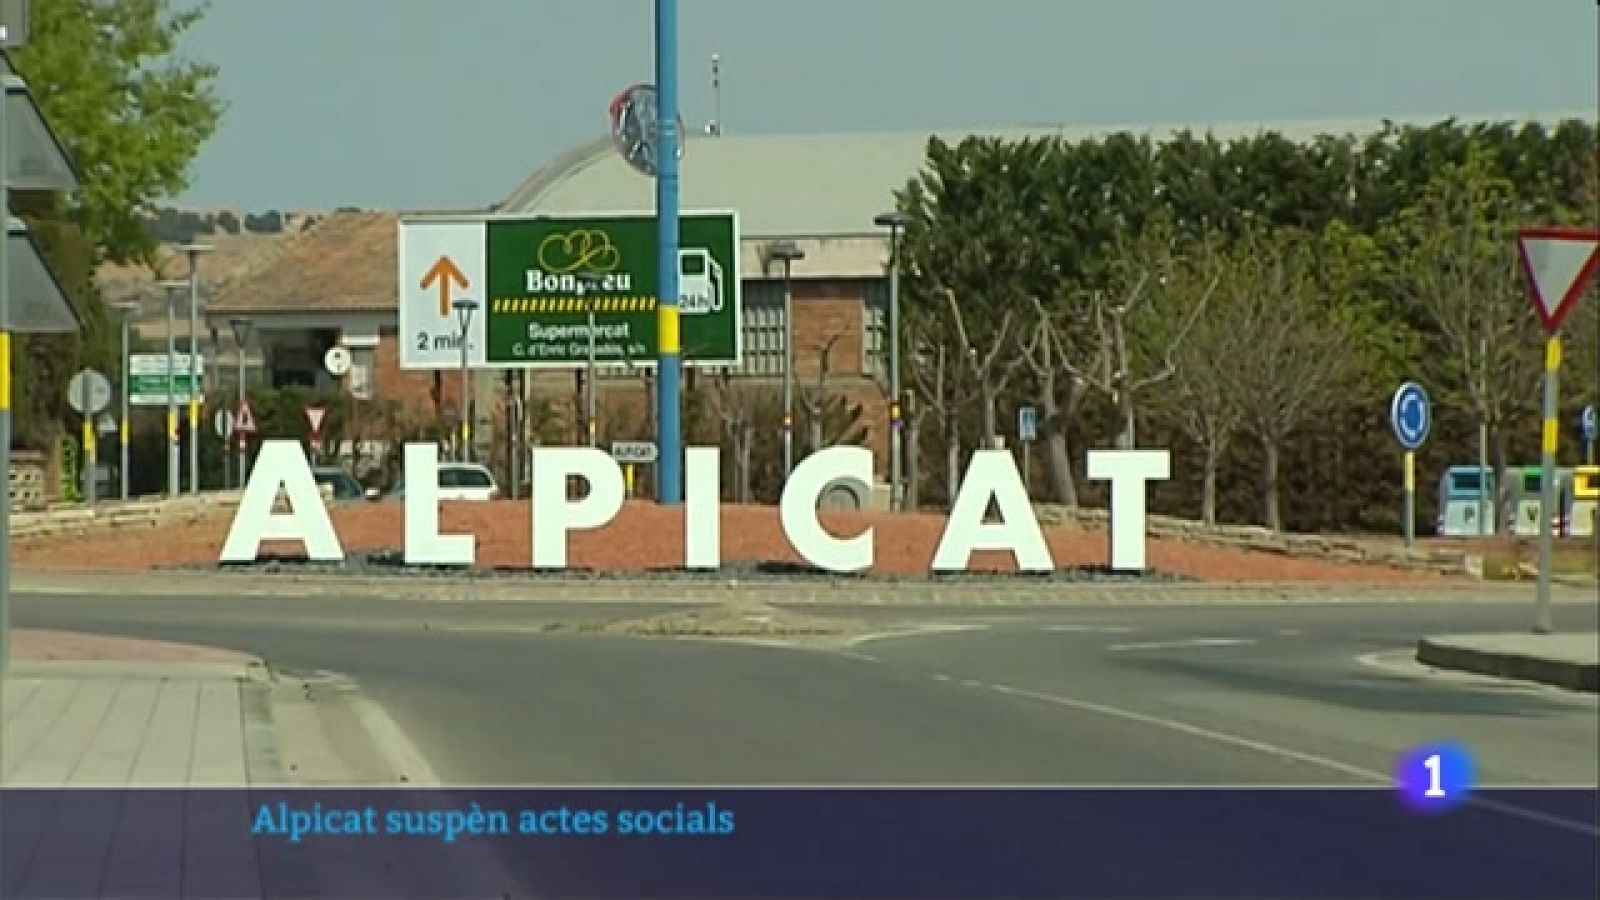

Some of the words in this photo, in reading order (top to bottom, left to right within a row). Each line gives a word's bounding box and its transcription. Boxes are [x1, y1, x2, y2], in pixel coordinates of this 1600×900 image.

[417, 332, 428, 350] 2
[219, 440, 1170, 571] ALPICAT
[1464, 506, 1476, 524] P
